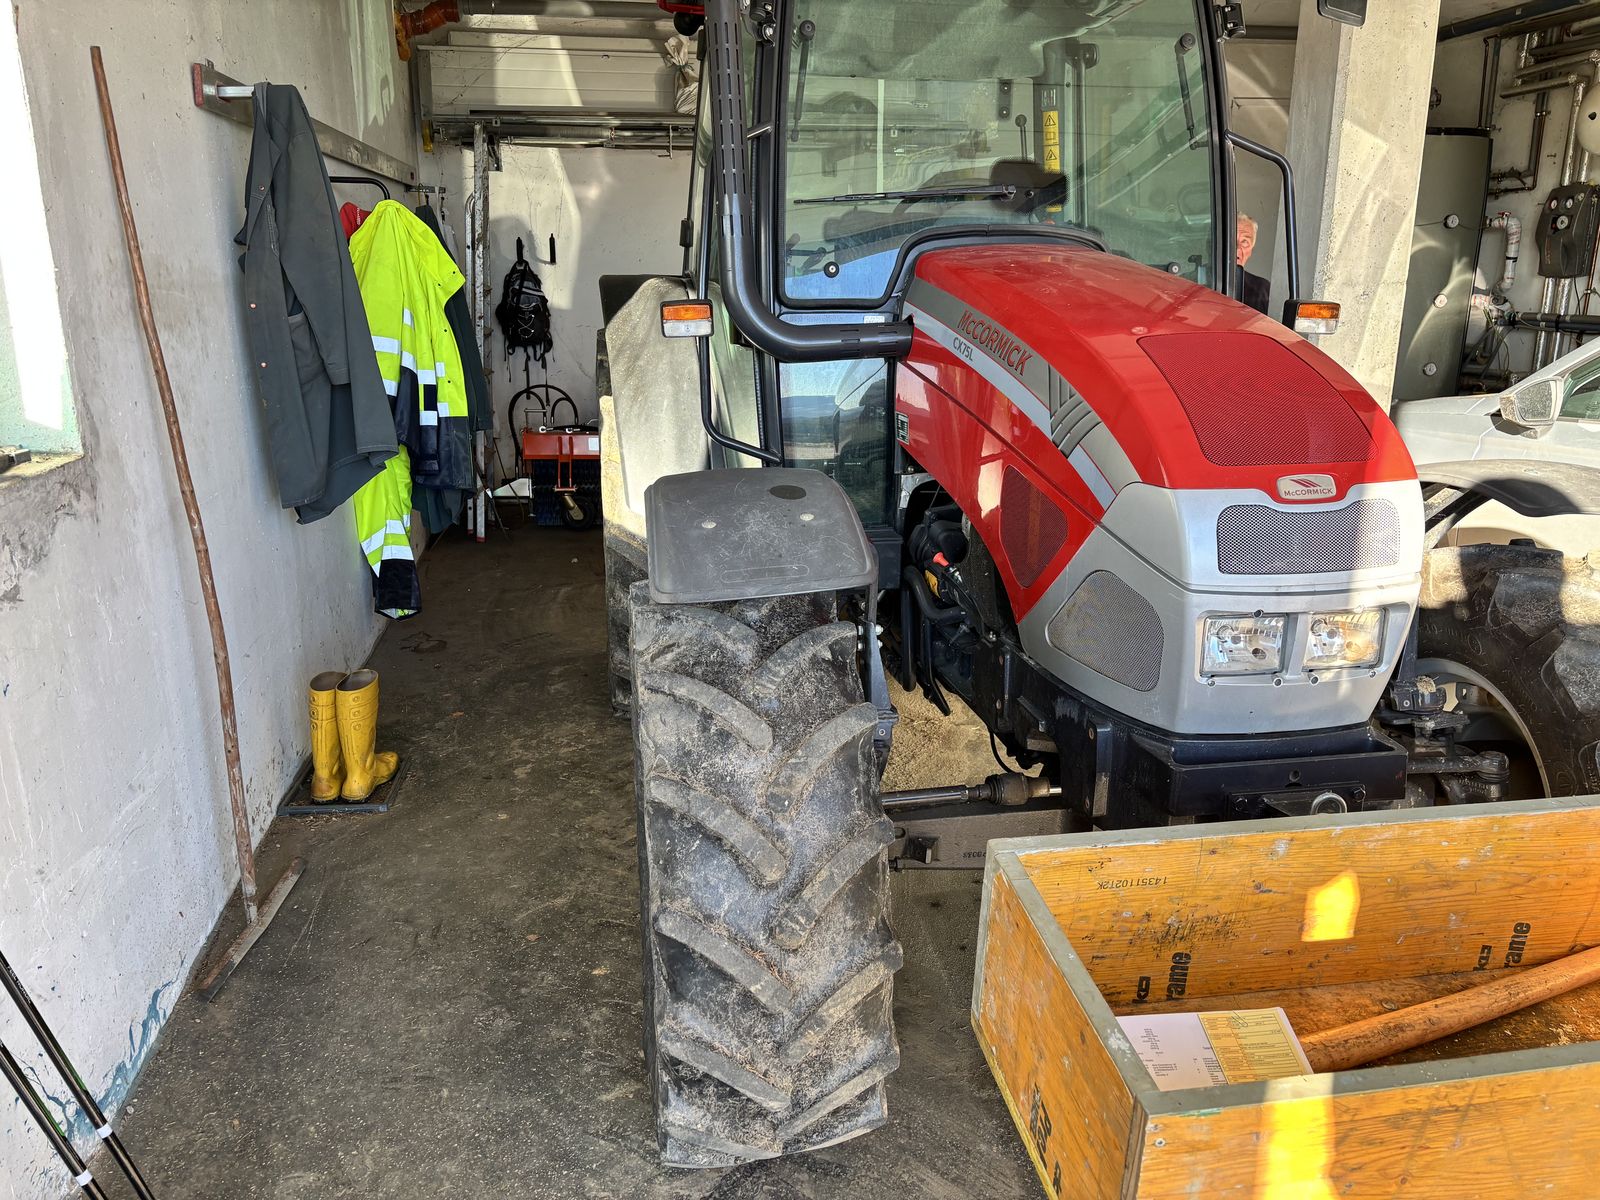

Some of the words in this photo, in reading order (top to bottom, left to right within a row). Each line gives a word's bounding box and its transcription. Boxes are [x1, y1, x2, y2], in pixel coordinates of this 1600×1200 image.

[953, 336, 974, 361] CX75L
[957, 310, 1032, 376] McCORMICK
[1283, 487, 1333, 497] McCORMICK
